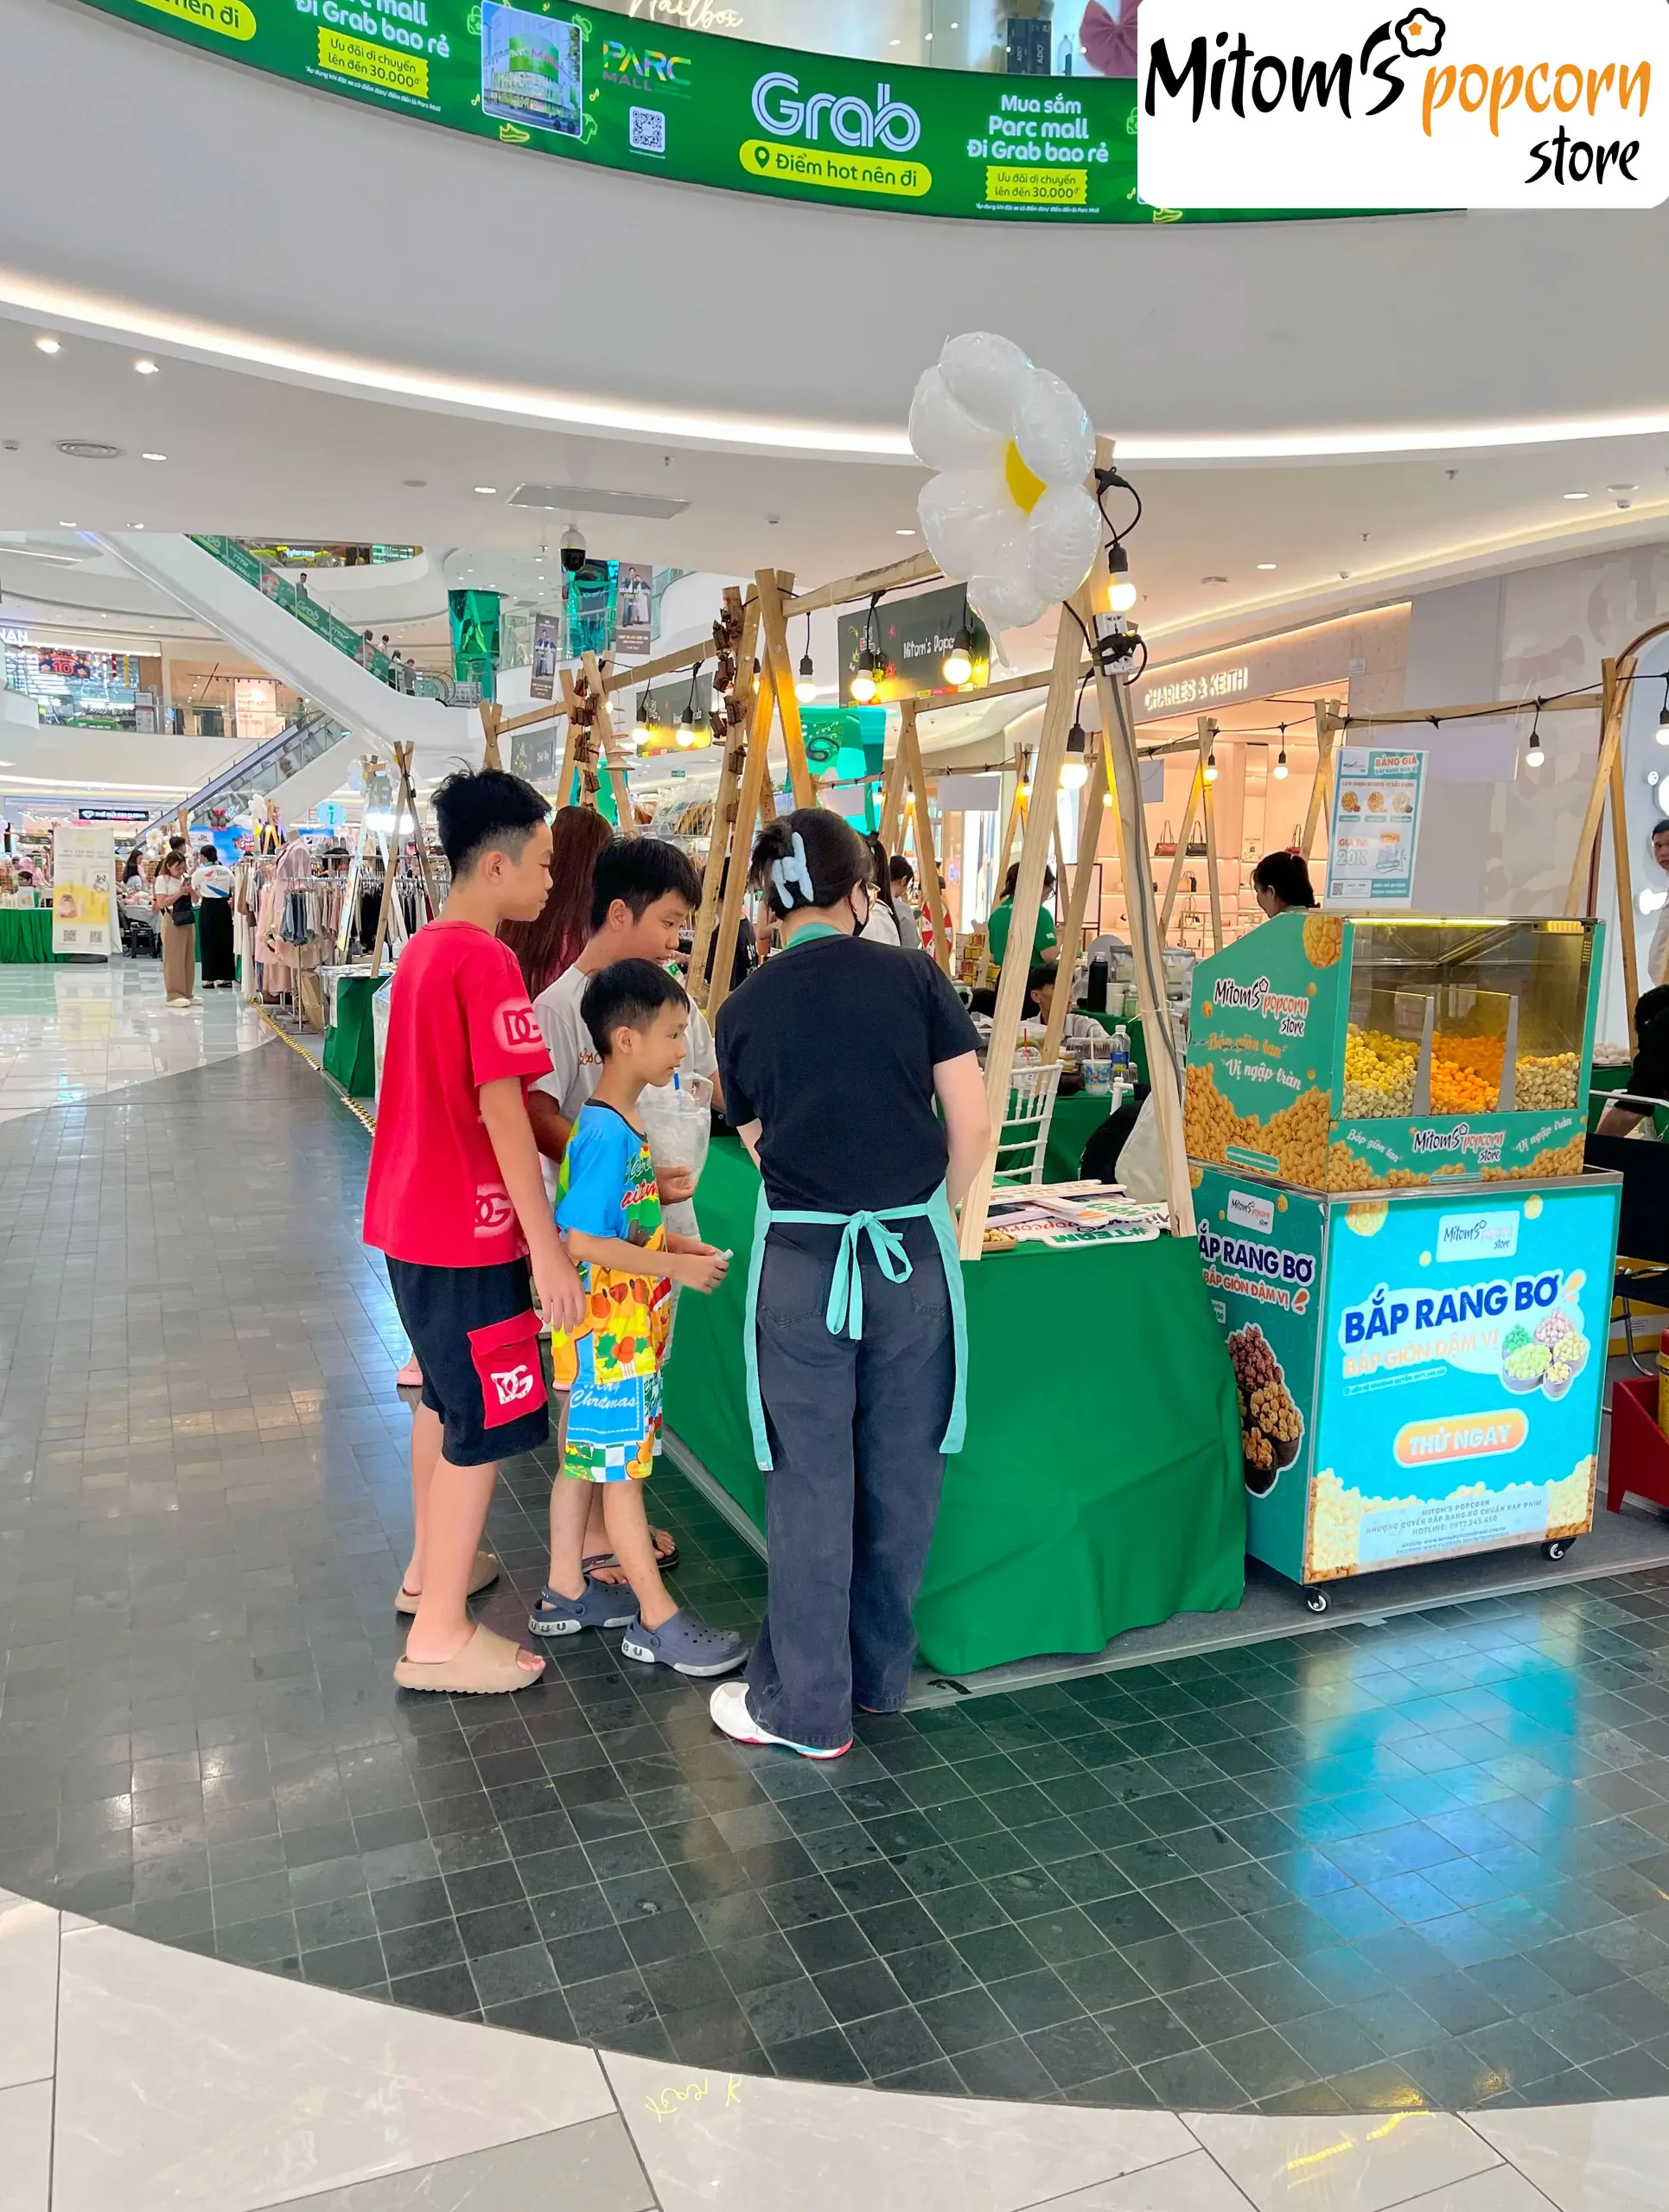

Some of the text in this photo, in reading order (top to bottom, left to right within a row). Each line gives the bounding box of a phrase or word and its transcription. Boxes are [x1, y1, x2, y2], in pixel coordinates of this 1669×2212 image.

[322, 1, 378, 35] Grab
[381, 17, 424, 49] bao
[428, 34, 449, 58] rẻ
[328, 53, 345, 67] lên
[347, 60, 367, 73] đến
[330, 37, 345, 51] Ưu
[347, 44, 364, 57] đãi
[379, 54, 416, 73] chuyển
[603, 40, 691, 86] PARC
[602, 71, 653, 92] MALL
[751, 72, 920, 152] Grab
[1001, 92, 1081, 114] Mua sắm
[989, 115, 1089, 139] Parc mall
[966, 138, 1109, 163] Đi Grab bao rẻ
[776, 153, 916, 187] Điểm hot nên đi
[997, 171, 1010, 182] Ưu
[1012, 173, 1028, 183] đãi
[1041, 173, 1076, 186] chuyển
[995, 186, 1010, 196] lên
[1012, 186, 1030, 197] đến
[1144, 666, 1248, 711] CHARLES & KEITH
[1336, 849, 1367, 866] 20K
[1263, 995, 1309, 1017] popcorn
[1282, 1018, 1303, 1036] store
[1244, 1062, 1274, 1082] ngập
[1277, 1068, 1302, 1091] tràn
[1347, 1129, 1366, 1145] Bắp
[1462, 1131, 1505, 1154] popcorn
[1529, 1127, 1553, 1147] ngập
[1554, 1117, 1572, 1131] tràn
[1480, 1150, 1500, 1163] store
[1050, 1227, 1149, 1243] #TEAM
[1223, 1240, 1279, 1274] RANG
[1283, 1254, 1313, 1283] BƠ
[1202, 1265, 1289, 1309] BẮP GIÒN ĐẬM VỊ
[1345, 1274, 1559, 1345] BẮP RANG BƠ
[1345, 1329, 1499, 1376] BẮP GIÒN ĐẬM VỊ
[490, 1365, 533, 1405] DG
[1410, 1425, 1512, 1456] THỬ NGAY
[1422, 1500, 1490, 1516] MITOM'S POPCORN
